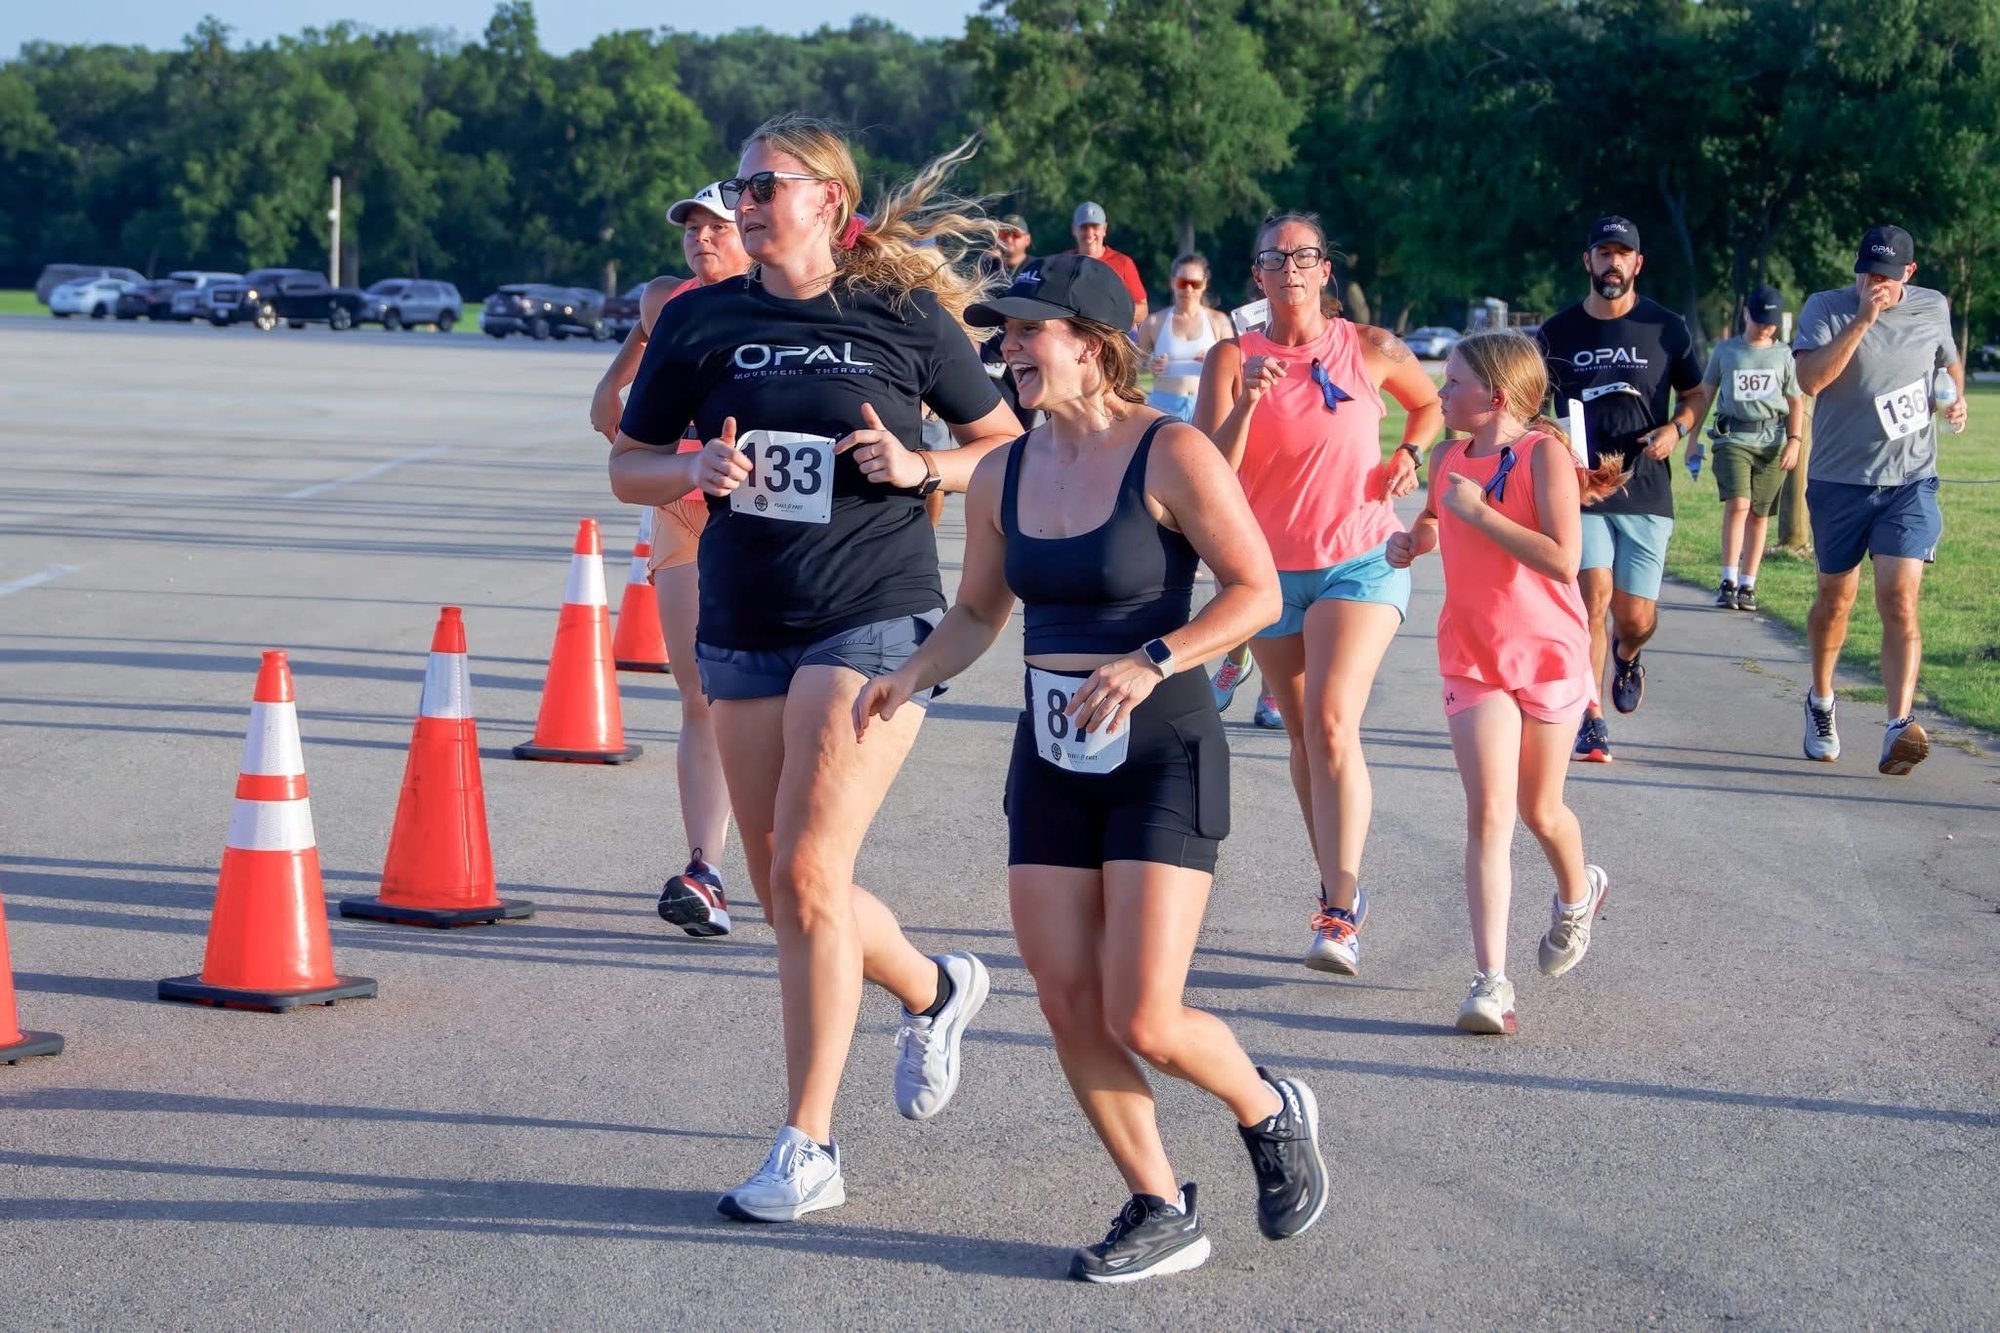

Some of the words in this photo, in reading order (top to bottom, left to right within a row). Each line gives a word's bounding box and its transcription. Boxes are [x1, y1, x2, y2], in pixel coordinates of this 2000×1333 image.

[734, 342, 874, 370] OPAL
[1573, 346, 1648, 366] OPAL
[734, 368, 804, 380] MOVEMENT
[815, 367, 874, 375] THERAPY
[1738, 374, 1771, 391] 367
[1883, 388, 1927, 425] 136
[741, 442, 822, 495] 133
